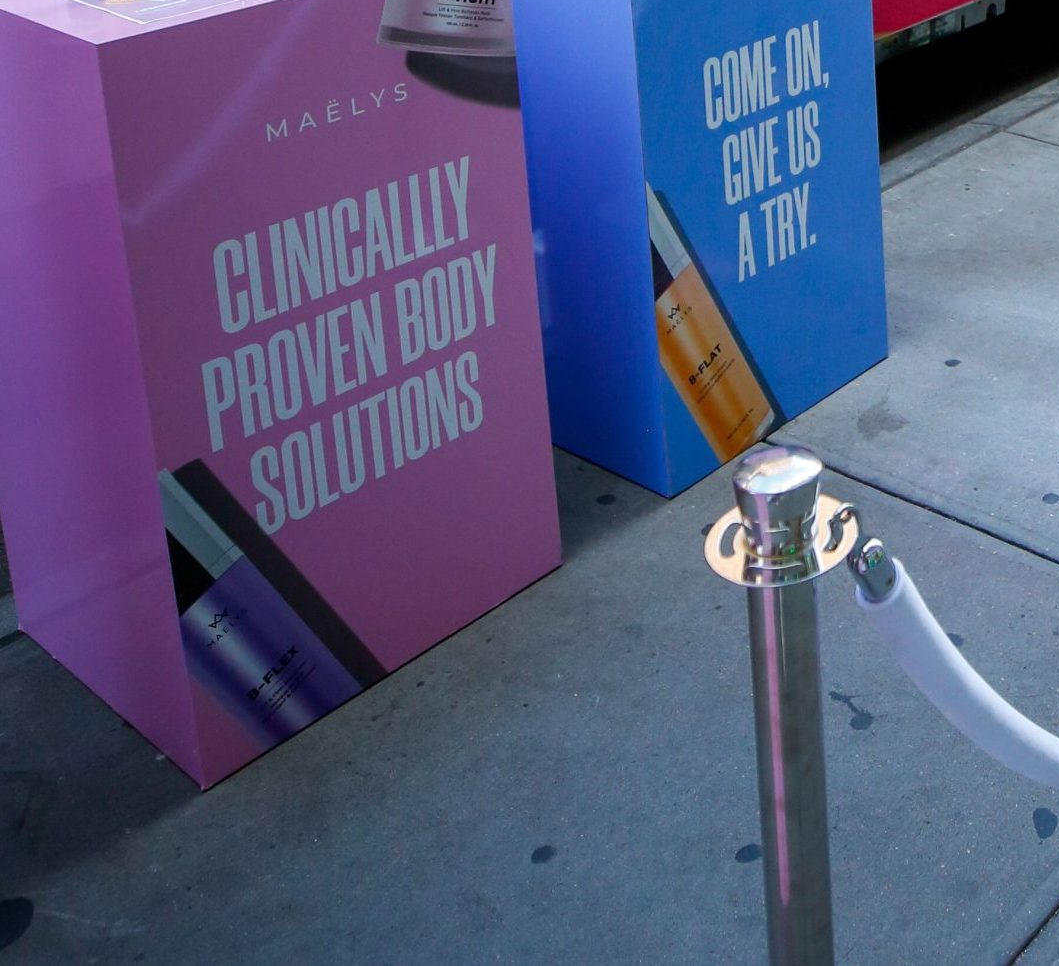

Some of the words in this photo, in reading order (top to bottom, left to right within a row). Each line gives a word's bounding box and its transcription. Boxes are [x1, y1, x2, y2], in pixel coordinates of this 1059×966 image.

[266, 83, 408, 142] MAËLYS
[703, 35, 780, 130] COME
[785, 19, 830, 88] ON,
[722, 116, 782, 206] GIVE
[787, 101, 821, 176] US
[213, 155, 469, 334] CLINICALLY
[738, 211, 756, 282] A
[760, 182, 816, 266] TRY.
[202, 292, 388, 452] PROVEN
[395, 244, 496, 366] BODY
[688, 343, 722, 386] B-FLAT
[250, 351, 483, 535] SOLUTIONS
[248, 645, 299, 700] B-FLEX
